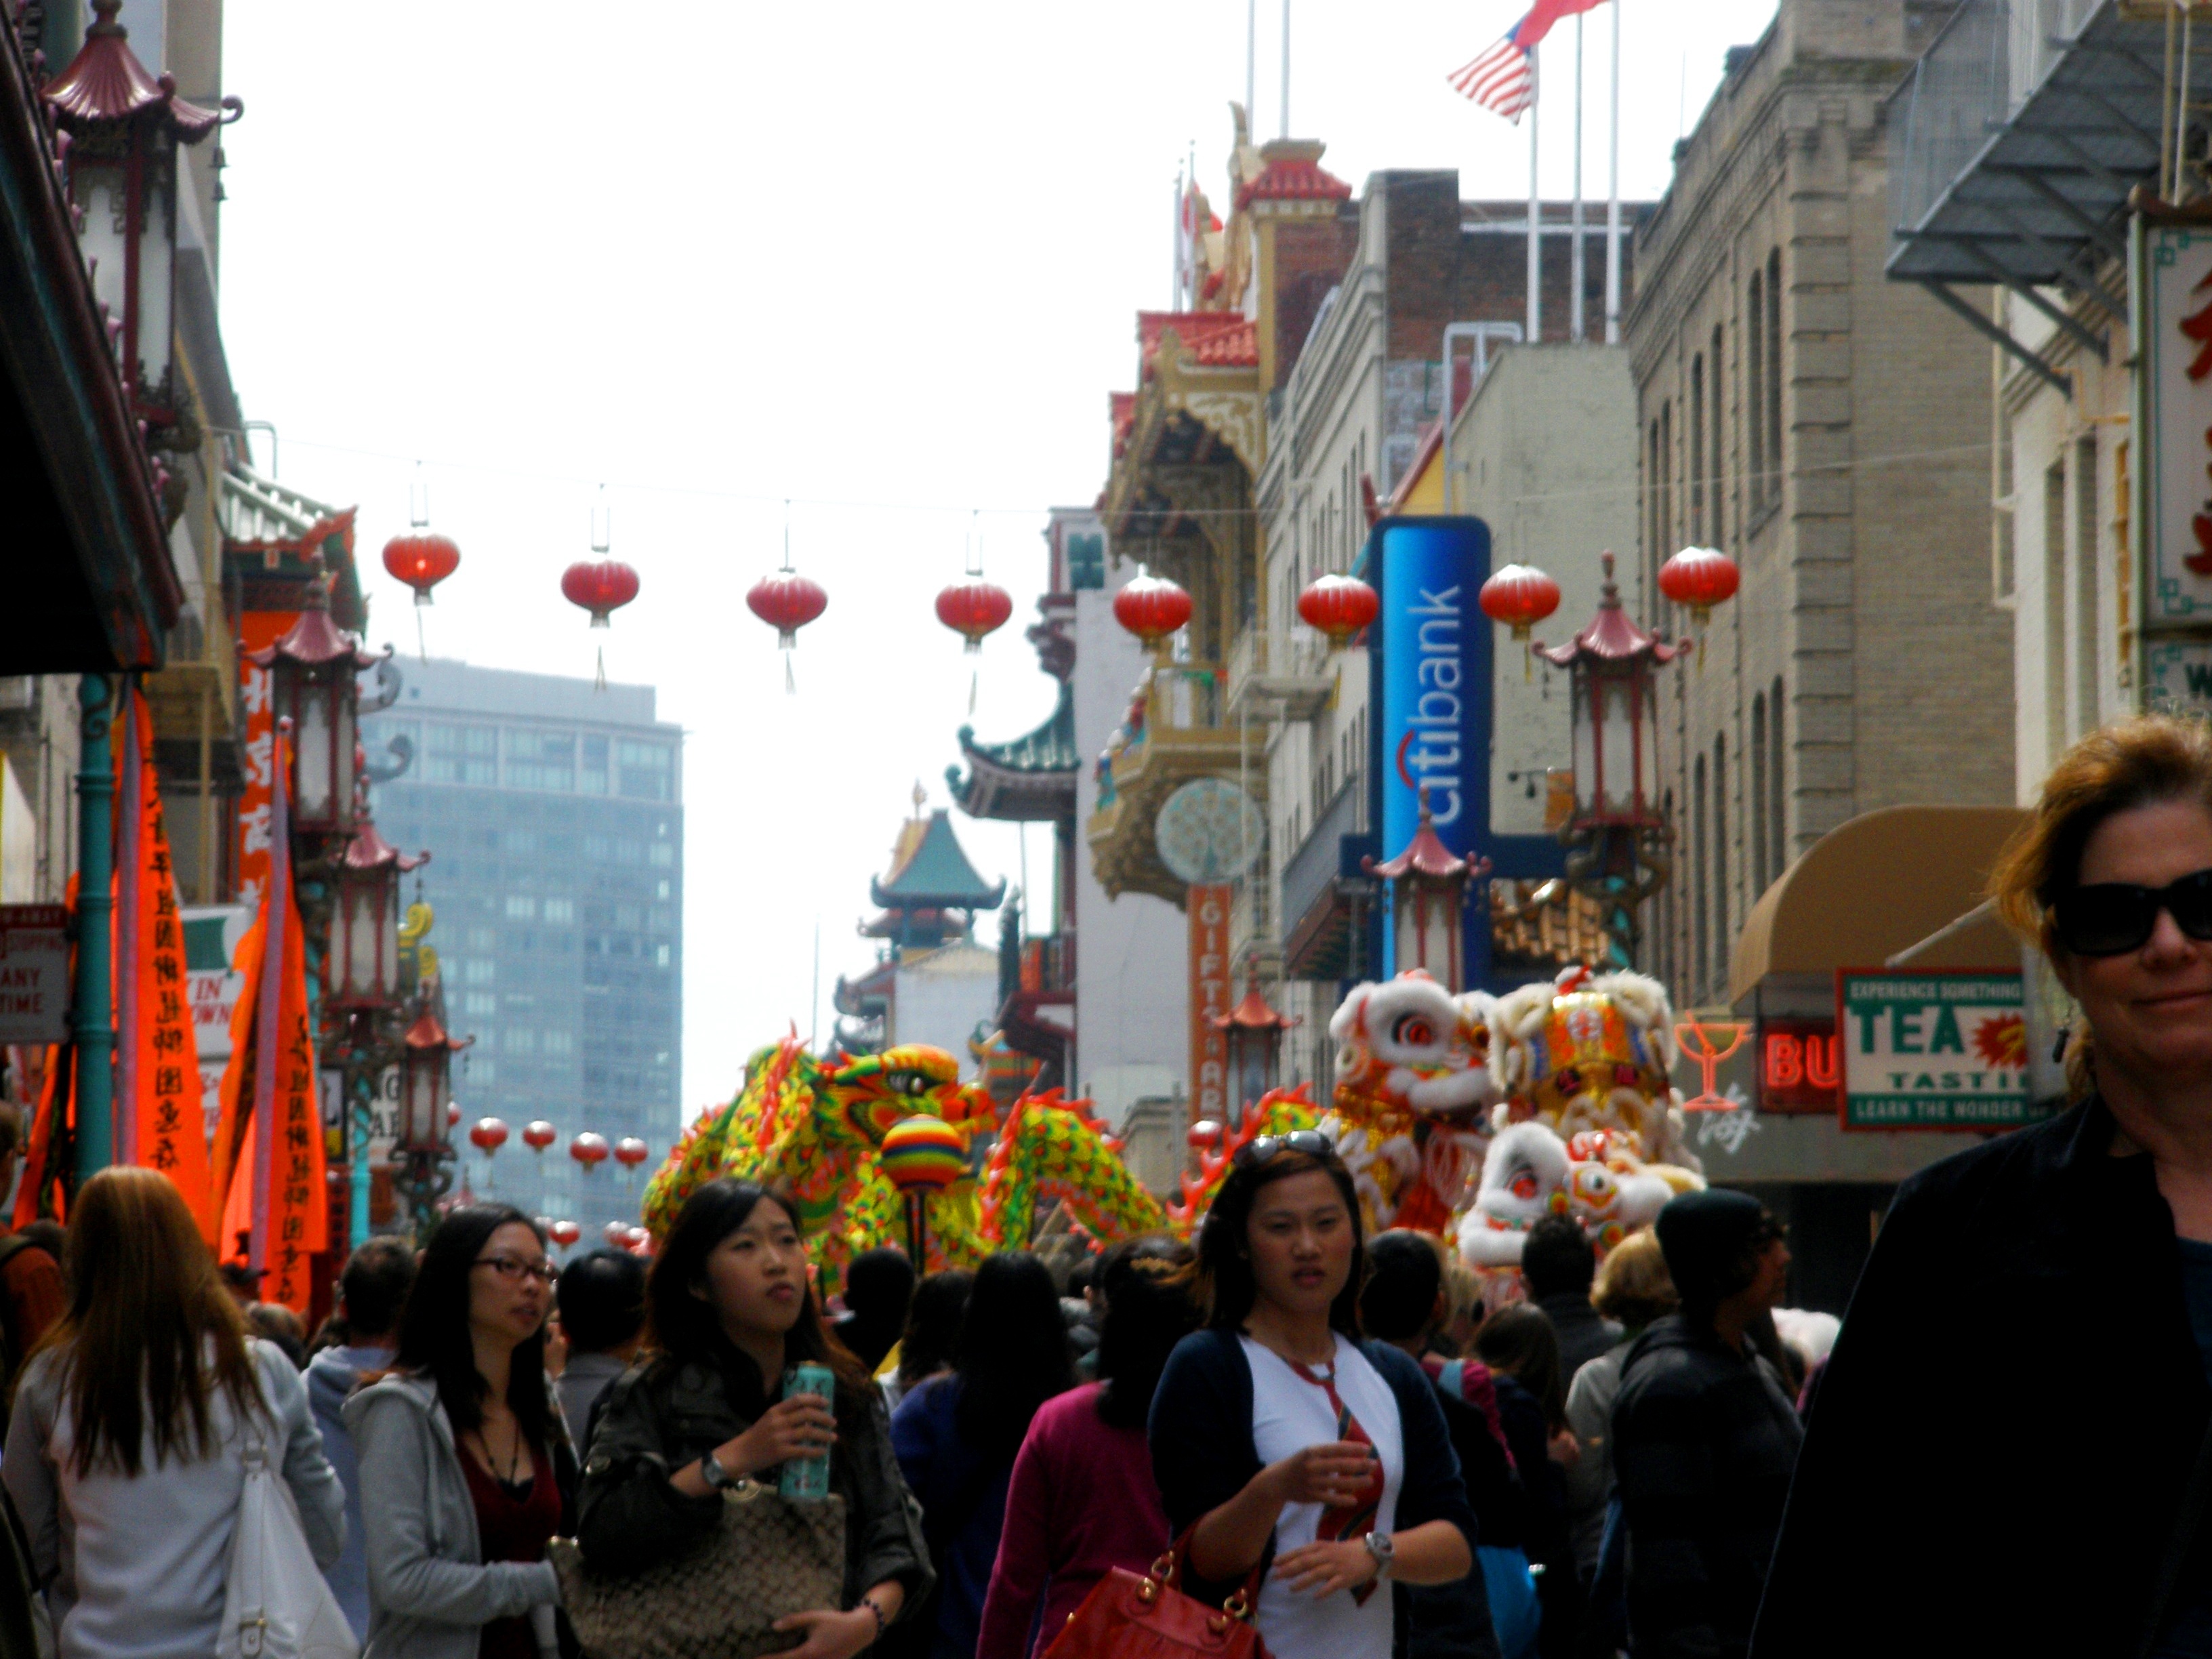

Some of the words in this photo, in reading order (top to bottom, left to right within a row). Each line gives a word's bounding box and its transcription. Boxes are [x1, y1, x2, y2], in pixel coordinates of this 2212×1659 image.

[1397, 585, 1461, 825] citibank
[1, 966, 41, 987] ANY
[195, 977, 222, 1000] IN
[1850, 982, 1936, 998] EXPERIENCE
[1940, 982, 2022, 998] SOMETHING
[0, 991, 44, 1015] TIME
[1850, 1002, 1964, 1054] TEA
[1767, 1033, 1839, 1088] BU
[1199, 1059, 1222, 1122] AR
[1856, 1099, 1910, 1118] LEARN
[1917, 1099, 1948, 1118] THE
[1953, 1099, 2022, 1118] WONDER
